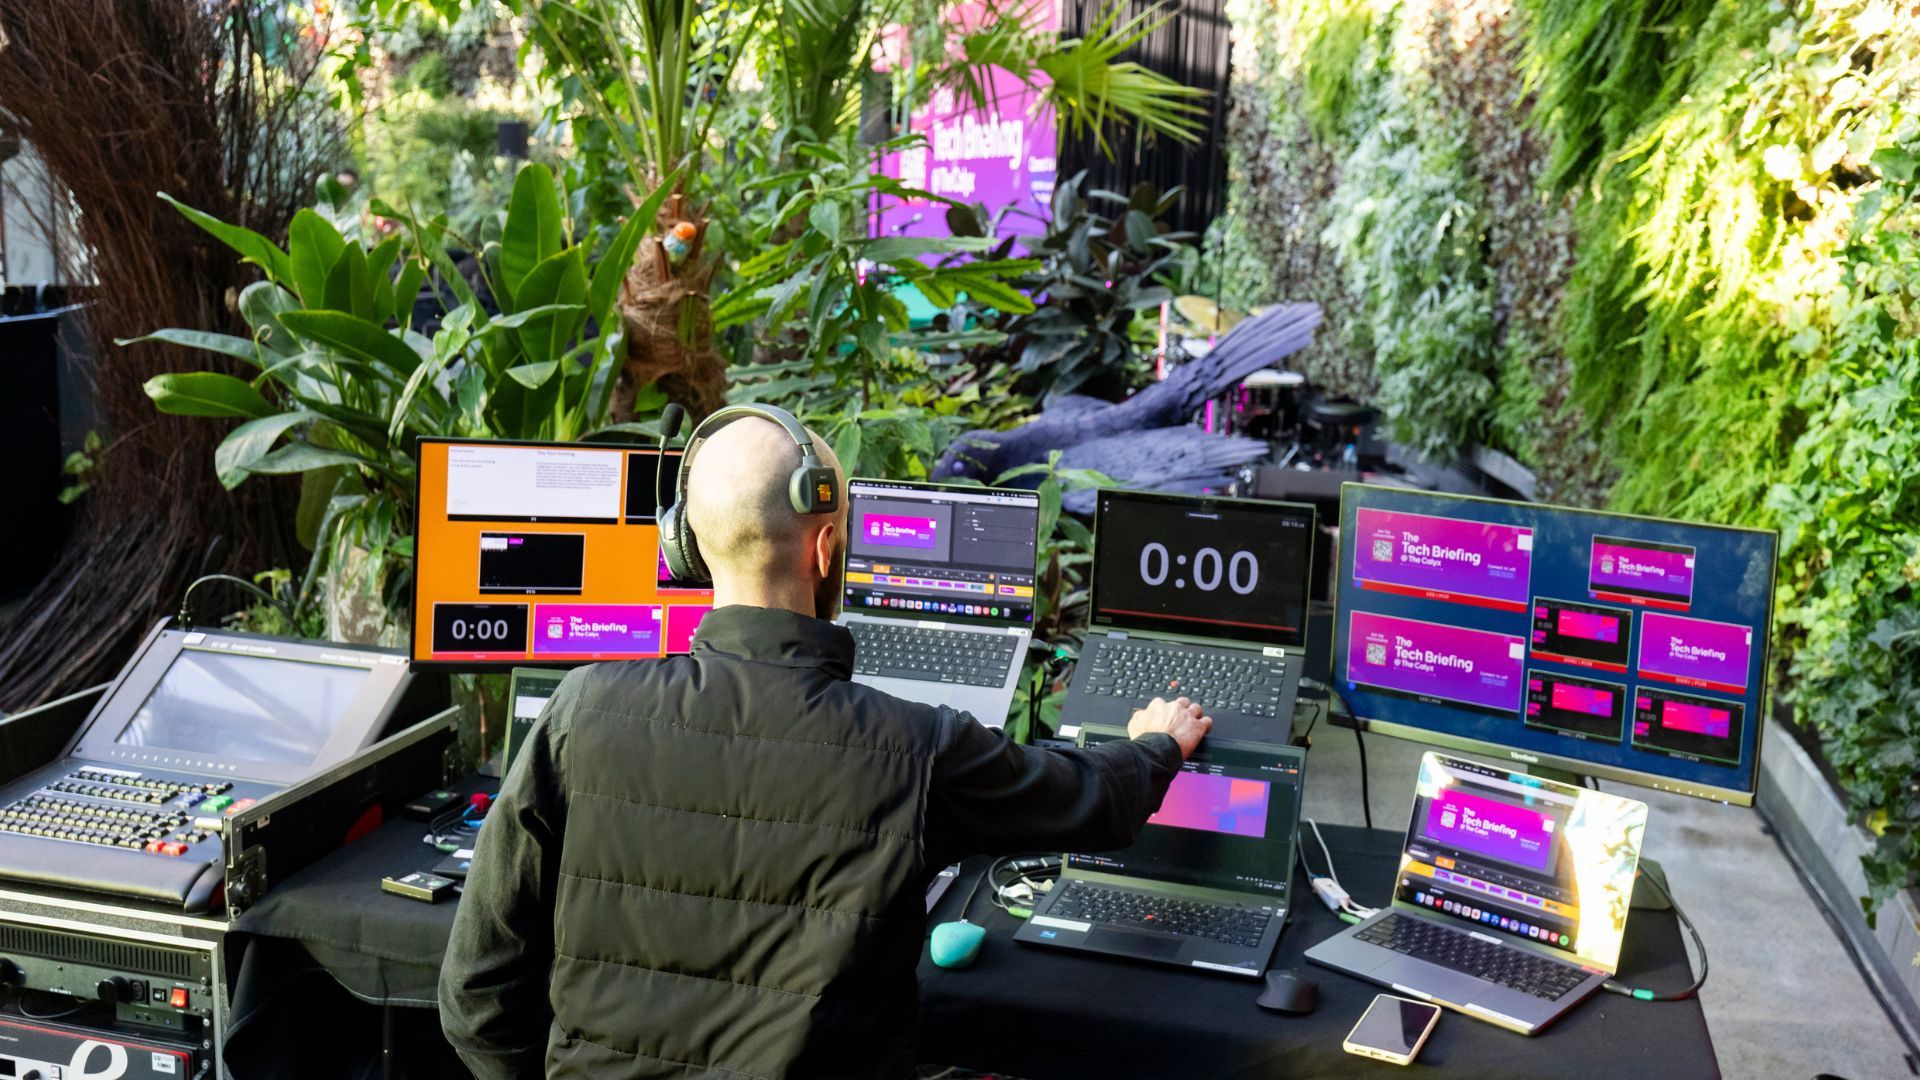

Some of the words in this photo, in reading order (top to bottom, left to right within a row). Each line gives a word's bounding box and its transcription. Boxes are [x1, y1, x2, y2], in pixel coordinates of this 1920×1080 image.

[932, 115, 961, 160] Tech
[962, 111, 1023, 170] Briefing
[1402, 532, 1420, 543] The
[1402, 542, 1430, 557] Tech
[1432, 546, 1481, 566] Briefing
[1421, 557, 1442, 567] Calyx
[1140, 542, 1259, 595] 0:00
[1618, 561, 1636, 570] Tech
[1636, 563, 1665, 577] Briefing
[452, 619, 508, 640] 0:00
[570, 623, 591, 632] Tech
[592, 623, 628, 634] Briefing
[1395, 636, 1412, 647] The
[1670, 636, 1683, 644] The
[1394, 646, 1423, 662] Tech
[1424, 650, 1474, 673] Briefing
[1670, 643, 1690, 655] Tech
[1691, 646, 1726, 662] Briefing
[1402, 659, 1414, 668] The
[1414, 661, 1435, 672] Calyx
[1463, 806, 1476, 816] The
[1462, 814, 1482, 828] Tech
[1482, 819, 1518, 839] Briefing
